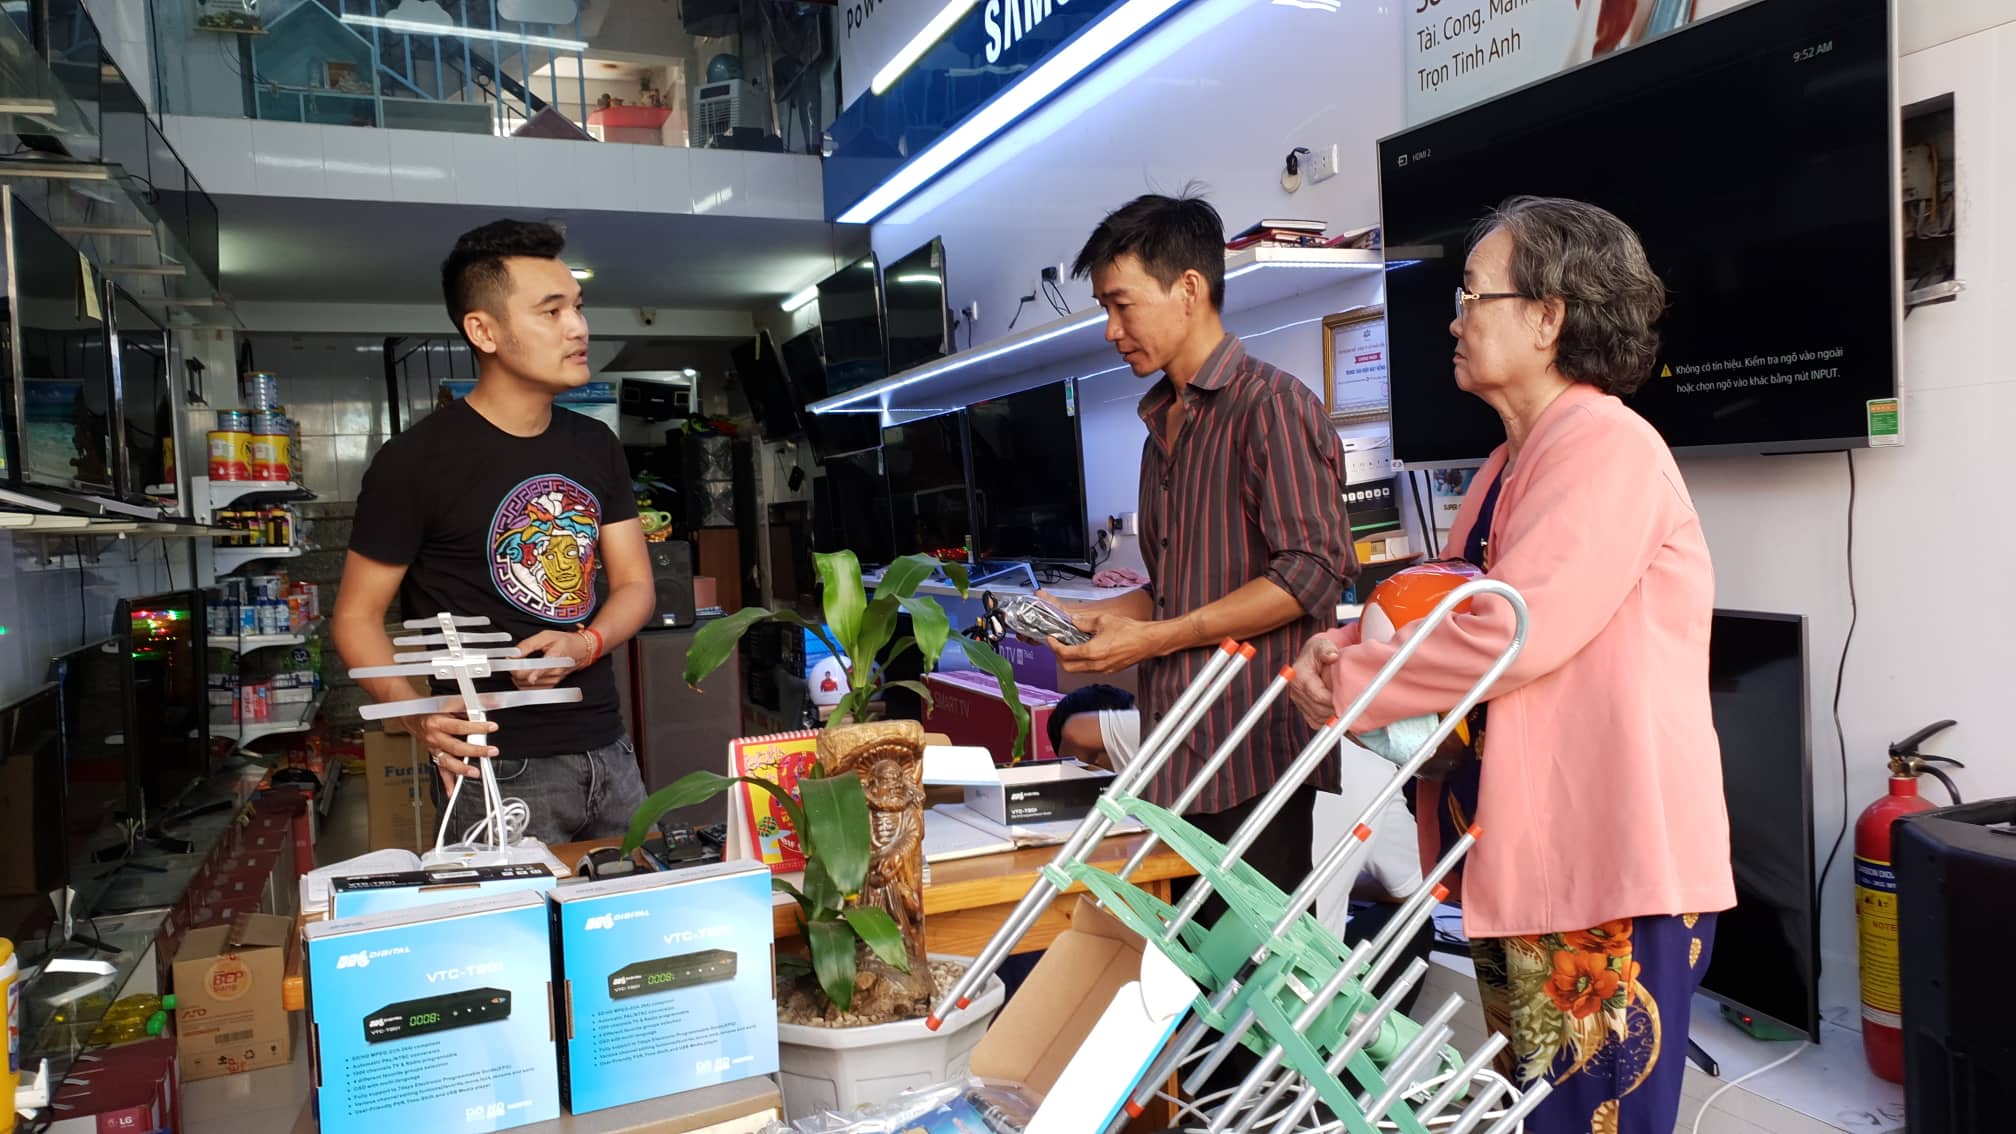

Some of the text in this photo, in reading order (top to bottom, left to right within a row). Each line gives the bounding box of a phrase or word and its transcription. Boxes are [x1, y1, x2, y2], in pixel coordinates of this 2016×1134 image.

[1417, 64, 1449, 92] Trọn
[1488, 28, 1521, 63] Anh
[1793, 41, 1833, 62] 9:52 AM
[1676, 365, 1700, 375] Không
[1701, 363, 1711, 372] có
[1712, 361, 1723, 370] tín
[1745, 354, 1765, 367] Kiểm
[1767, 355, 1779, 364] tra
[1780, 352, 1797, 365] ngõ
[1799, 350, 1816, 361] vào
[1817, 346, 1844, 360] ngoài
[1676, 382, 1695, 394] hoặc
[1696, 380, 1715, 391] chọn
[1716, 379, 1732, 391] ngõ
[1733, 378, 1748, 387] vào
[1749, 376, 1769, 386] khác
[1794, 371, 1809, 381] nút
[1810, 368, 1841, 380] INPUT.
[369, 945, 411, 959] DIGITAL
[119, 1116, 133, 1125] LG
